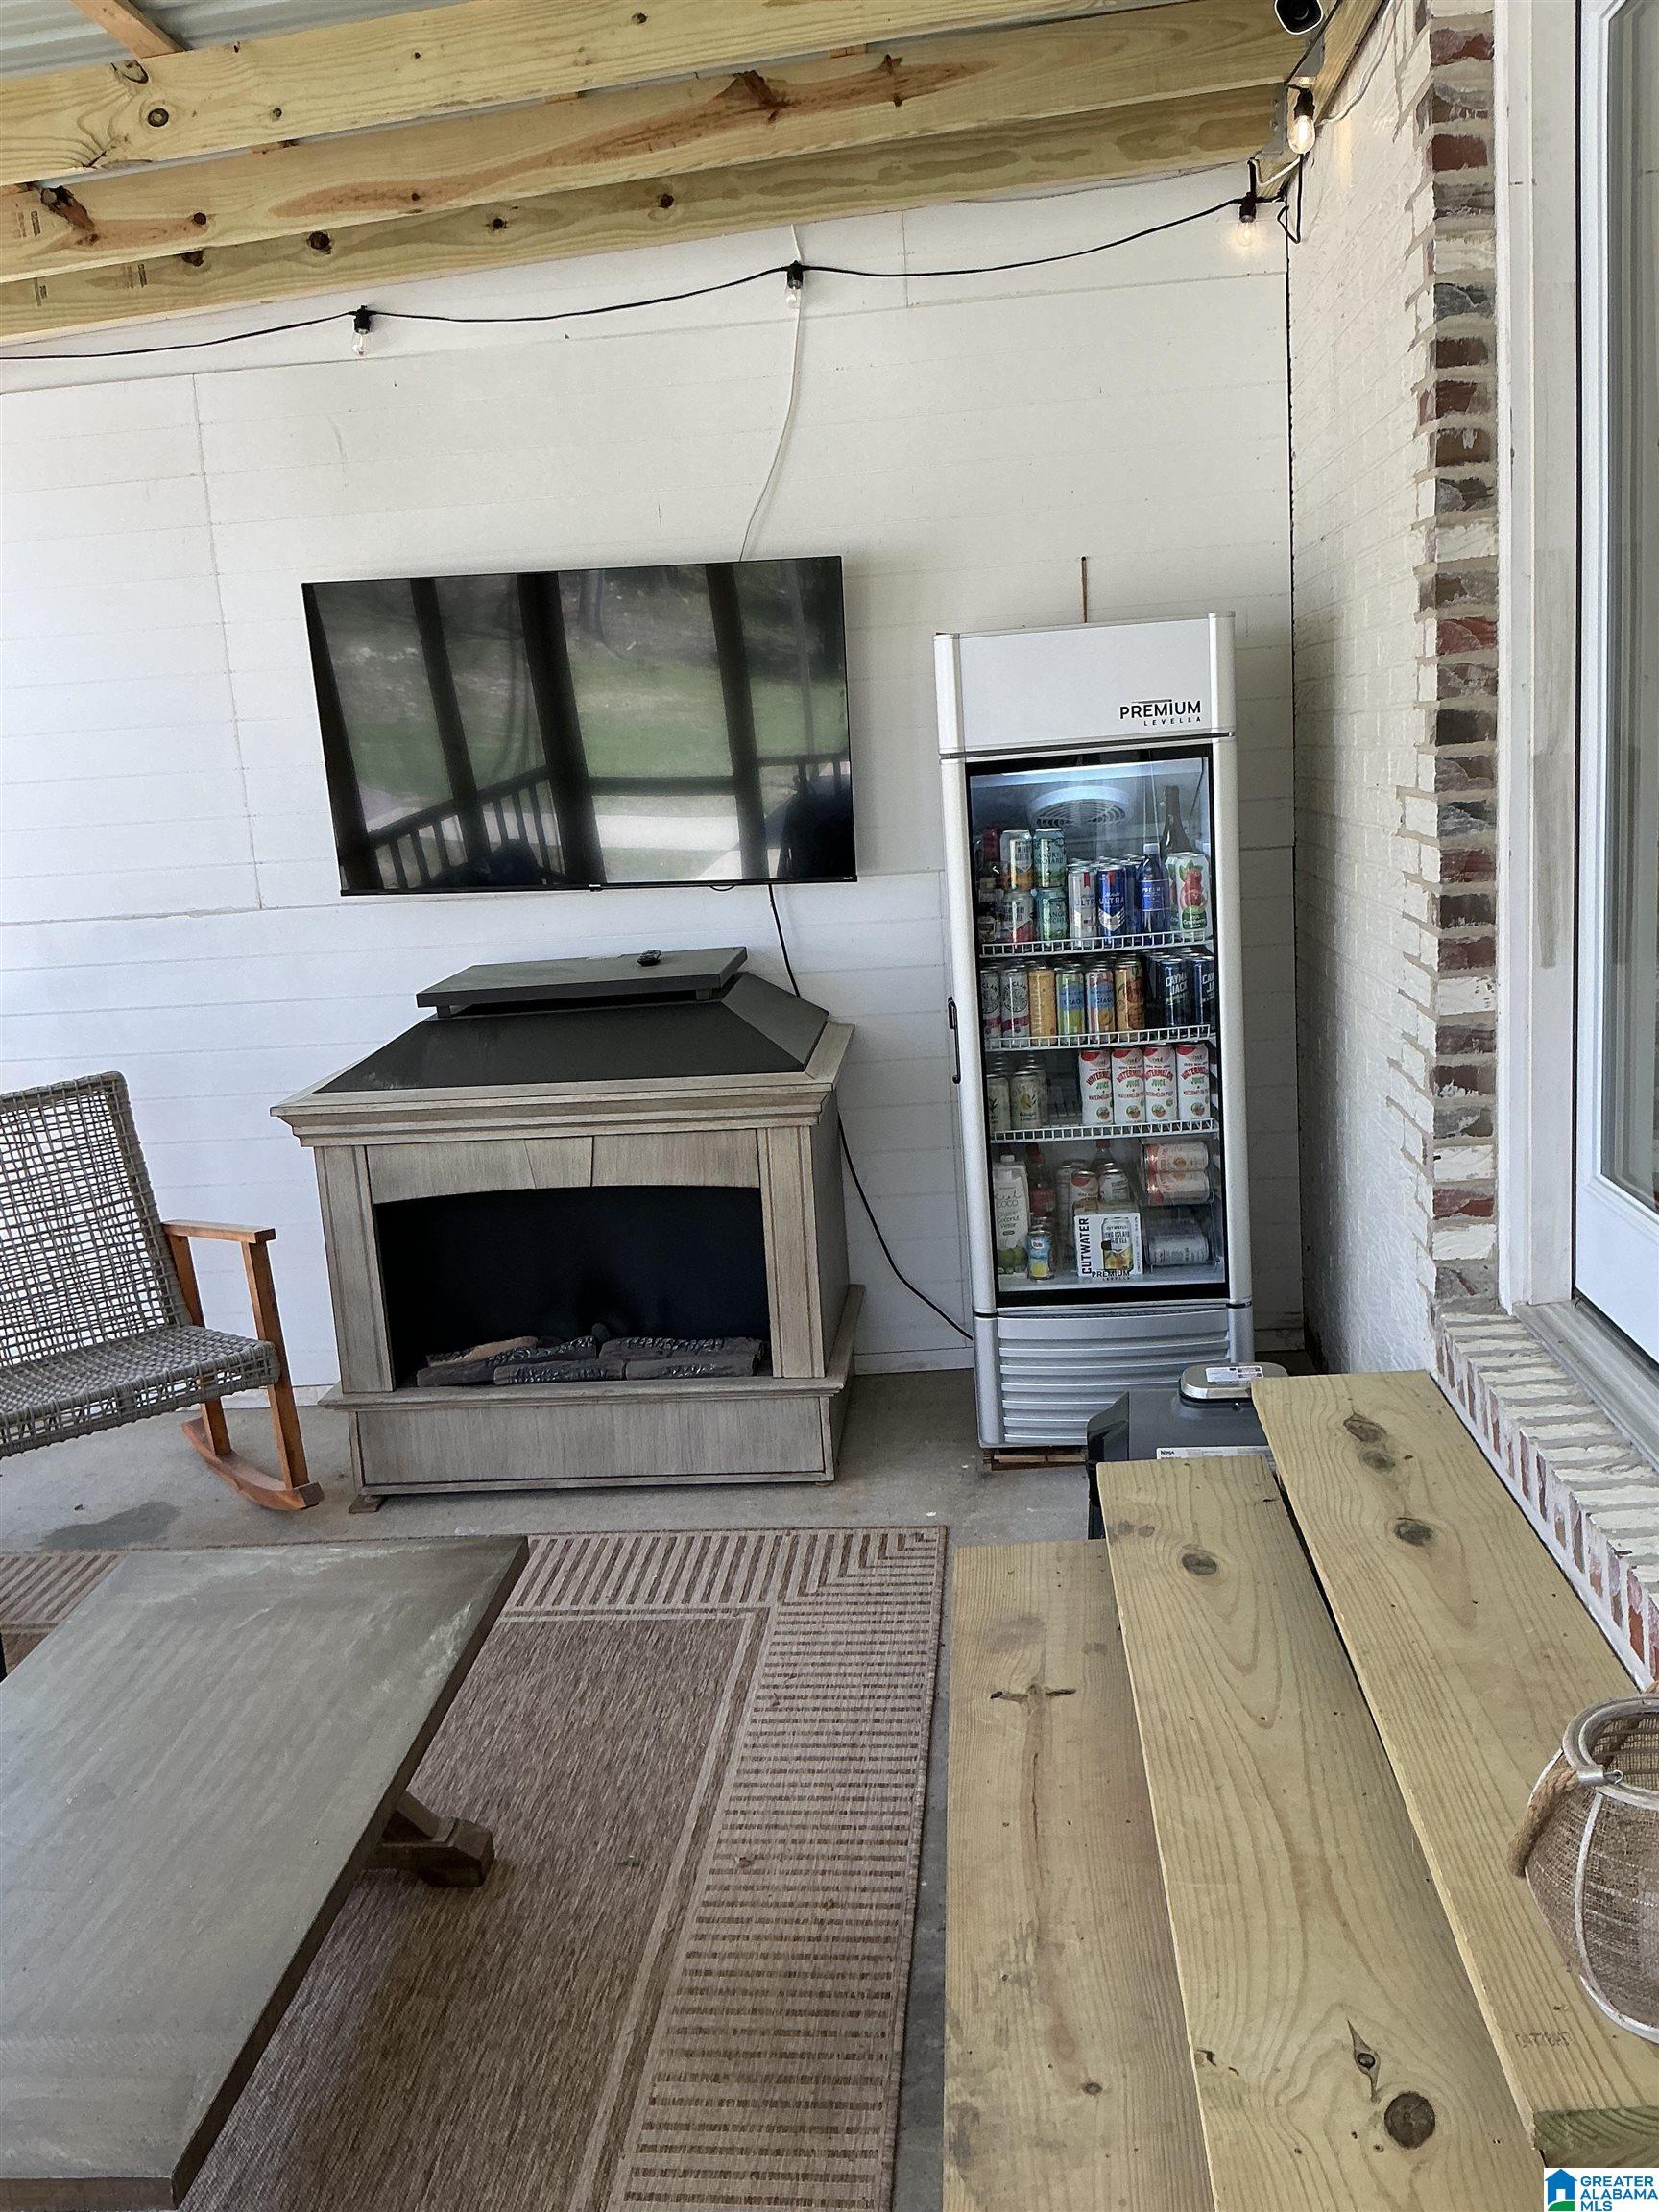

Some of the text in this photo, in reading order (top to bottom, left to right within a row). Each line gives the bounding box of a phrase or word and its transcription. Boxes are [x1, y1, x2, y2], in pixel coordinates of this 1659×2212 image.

[1119, 700, 1201, 719] PREMIUM
[1143, 716, 1201, 726] LEVELLA
[1099, 895, 1124, 905] ULTRA
[1078, 1217, 1093, 1275] CUTWATER
[1092, 1269, 1130, 1278] PREMIUM
